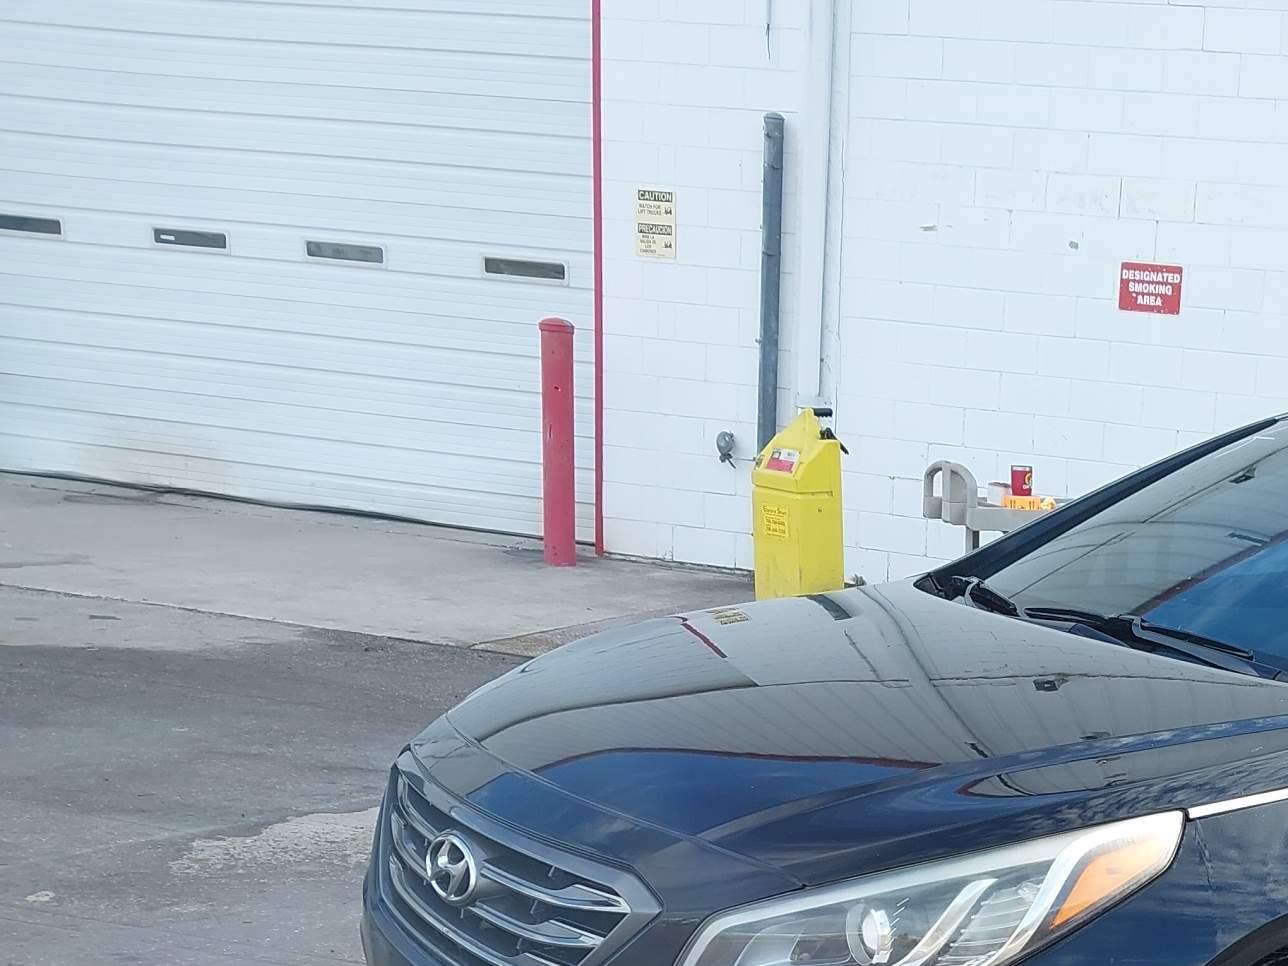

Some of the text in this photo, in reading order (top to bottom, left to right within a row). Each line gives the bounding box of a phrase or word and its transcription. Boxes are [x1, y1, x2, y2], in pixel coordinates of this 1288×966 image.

[639, 191, 671, 201] CAUTION
[1122, 269, 1180, 283] DESIGNATED
[1128, 281, 1172, 296] SMOKING
[1136, 295, 1163, 306] AREA
